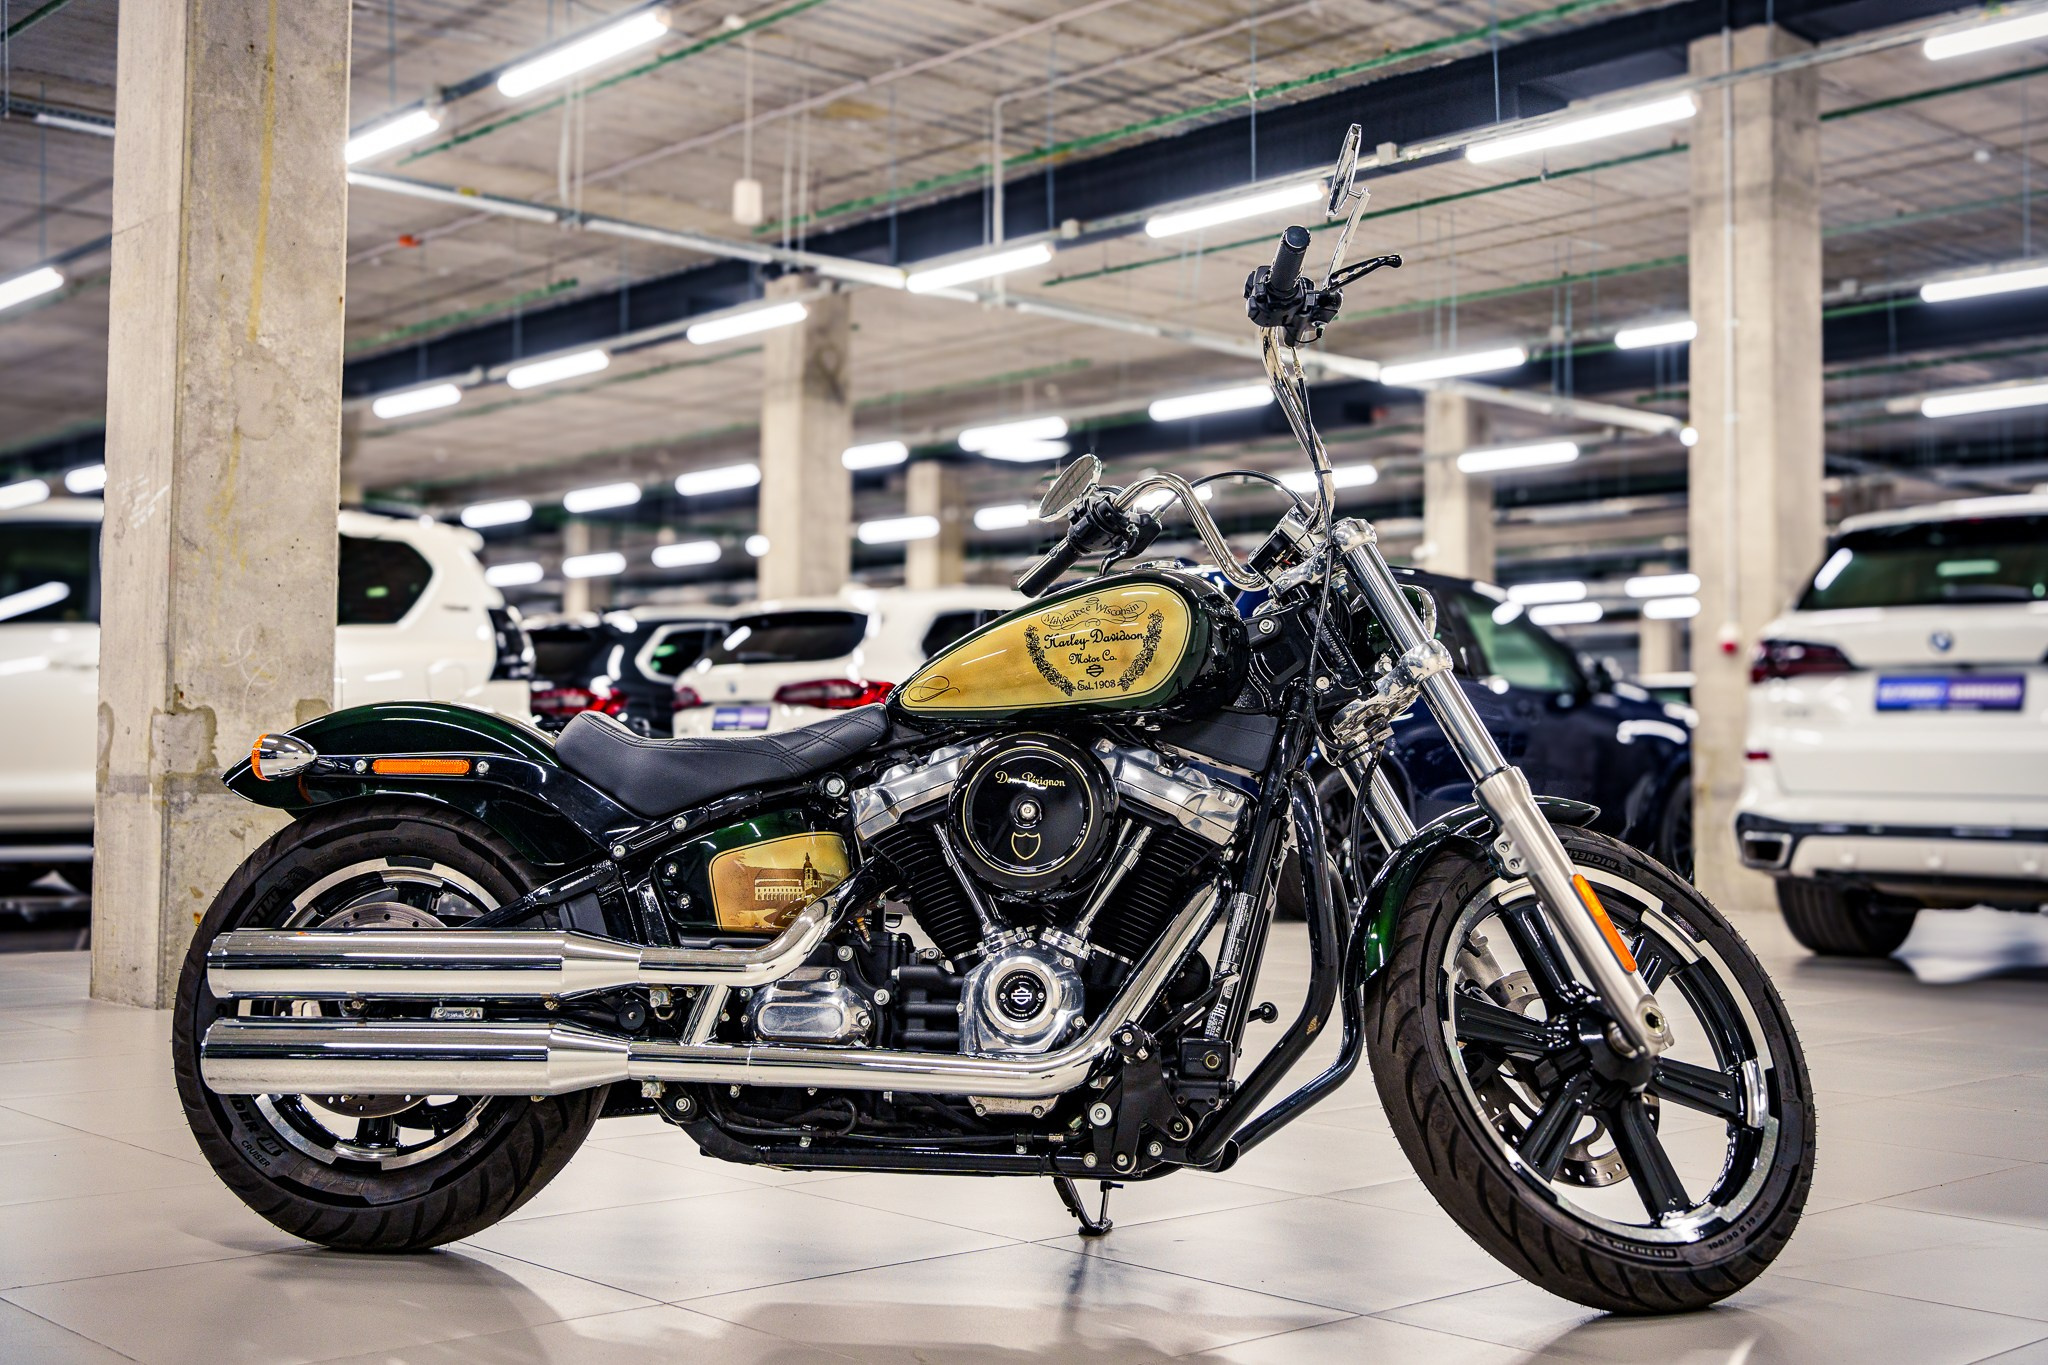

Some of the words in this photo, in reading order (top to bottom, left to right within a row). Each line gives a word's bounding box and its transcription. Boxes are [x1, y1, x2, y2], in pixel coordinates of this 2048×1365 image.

[1095, 601, 1140, 618] Wisconsin
[1044, 629, 1144, 650] Harley-Davidson
[1069, 653, 1100, 665] Motor
[1102, 650, 1117, 662] Co.
[1566, 850, 1617, 869] MICHELI
[241, 1140, 271, 1168] CRUISER
[1612, 1241, 1674, 1257] MICHELIN
[1708, 1231, 1739, 1249] 100/90
